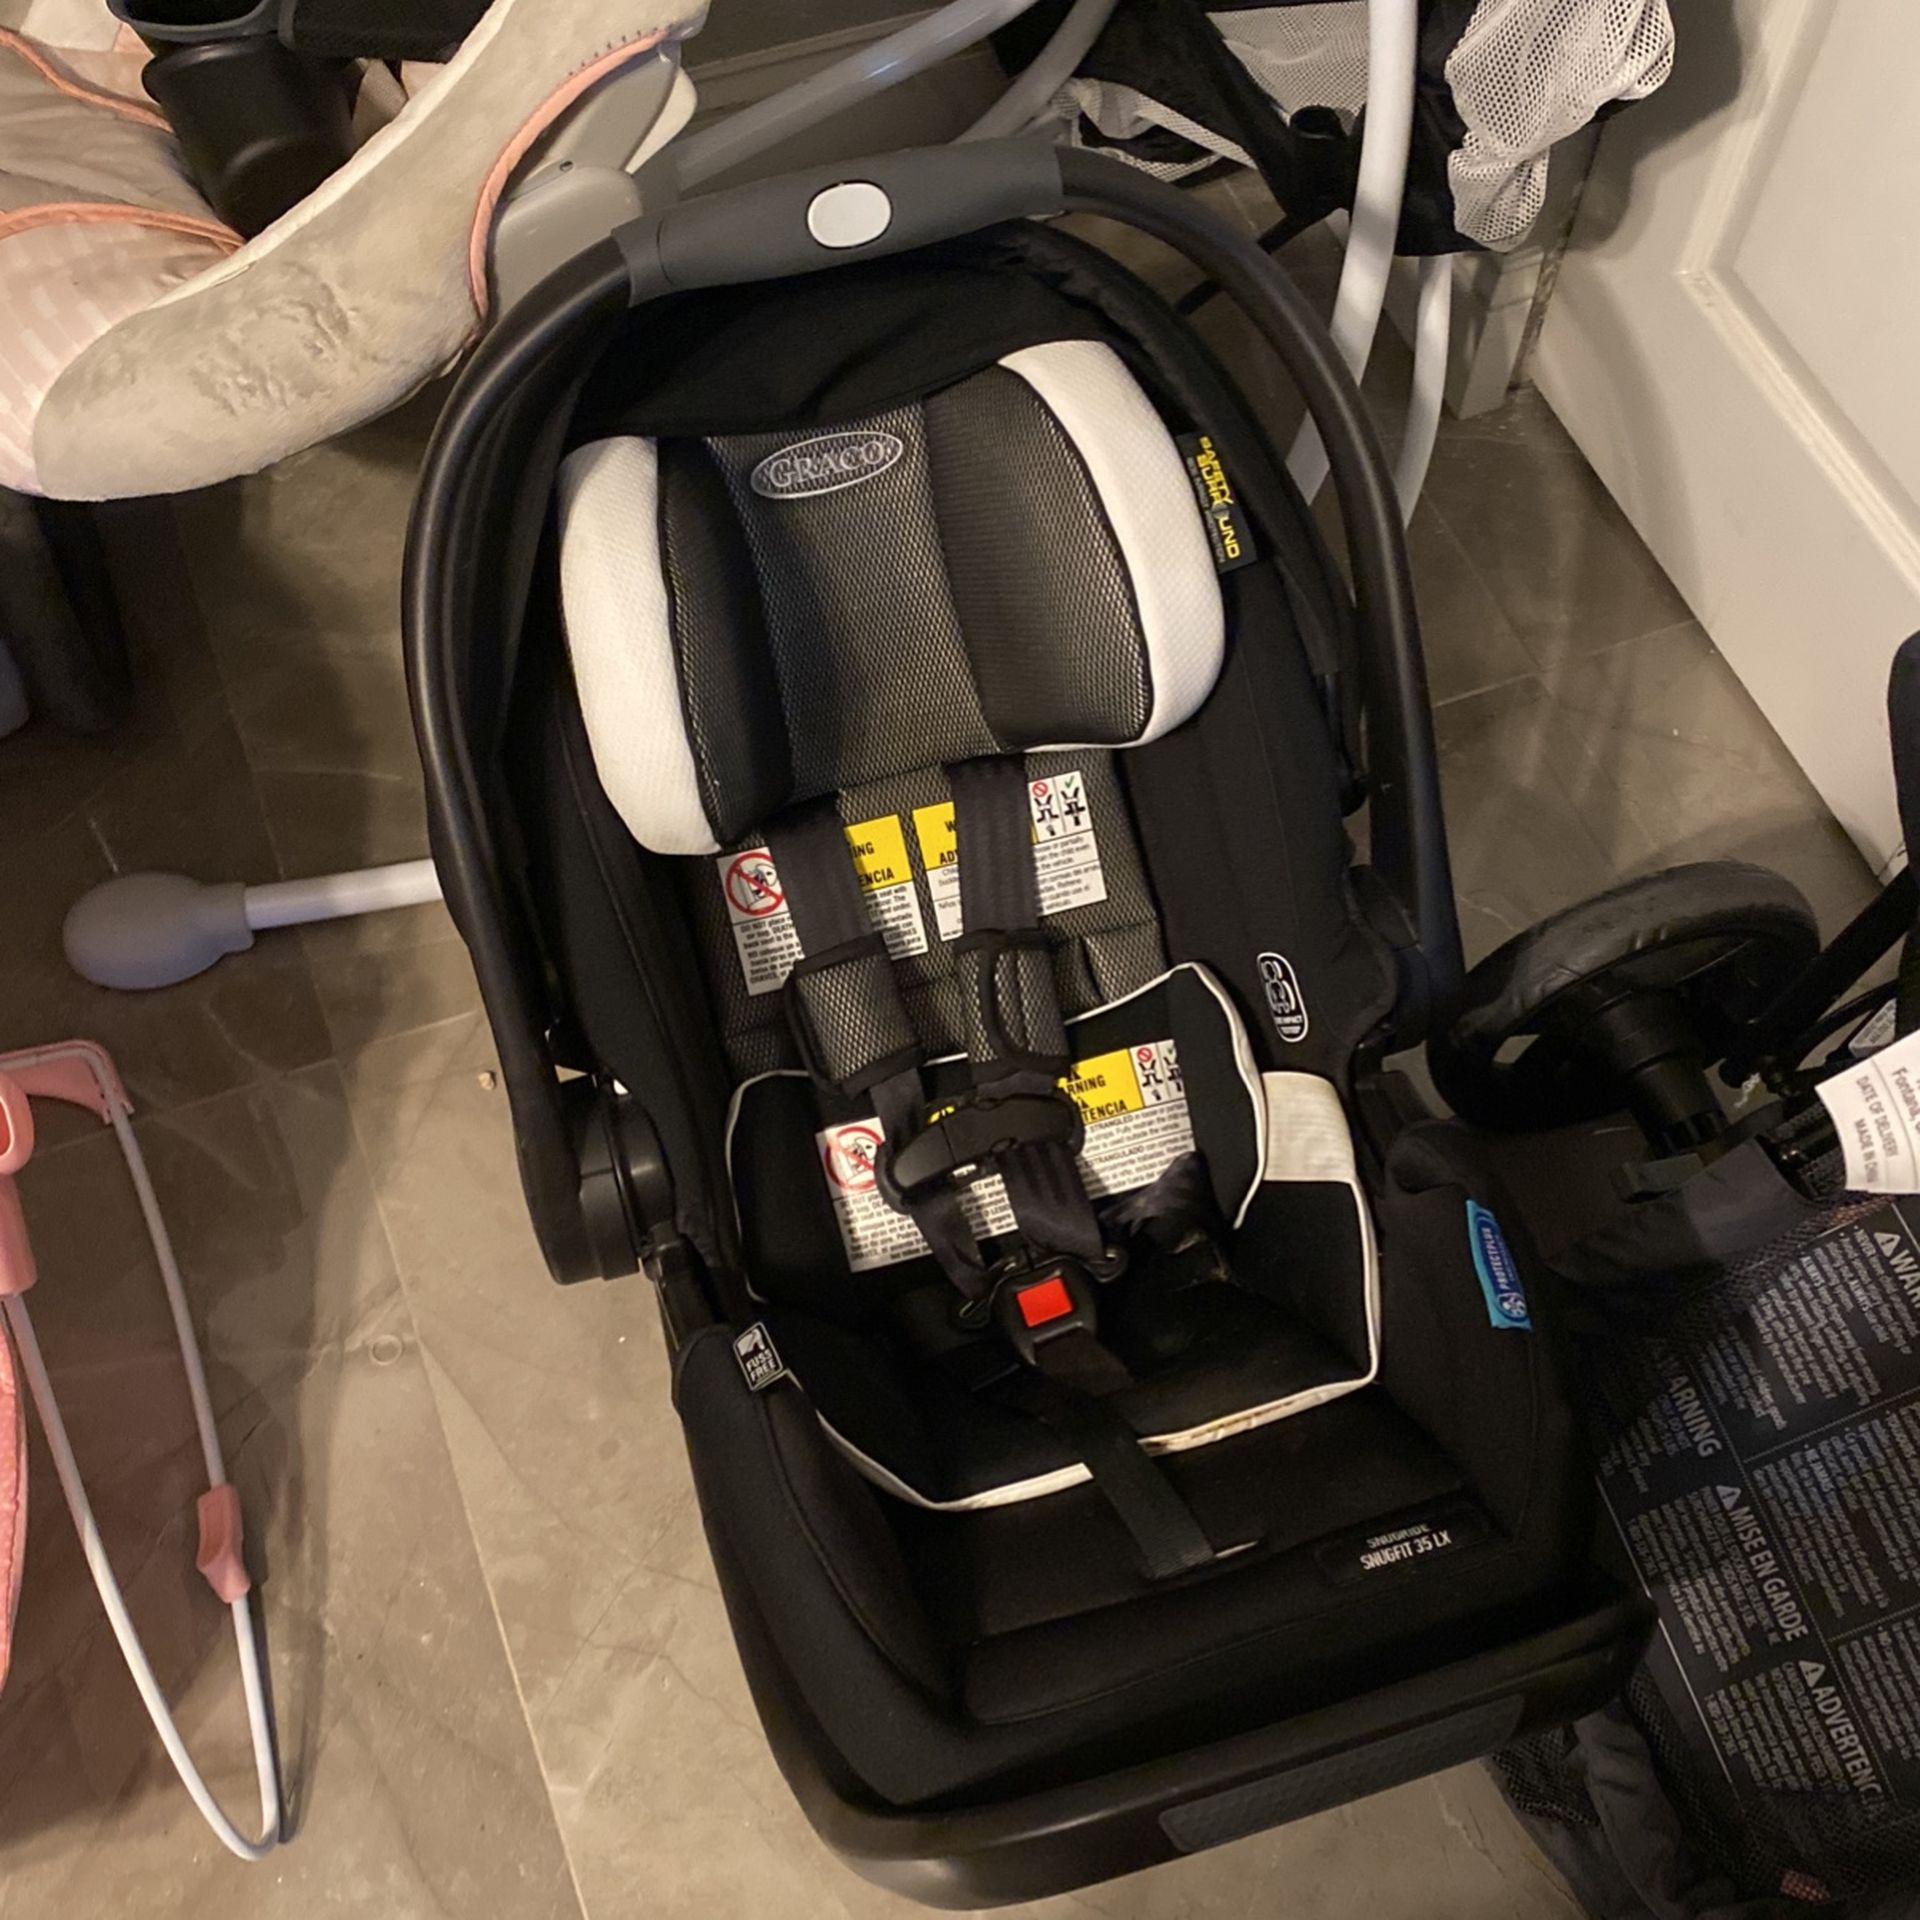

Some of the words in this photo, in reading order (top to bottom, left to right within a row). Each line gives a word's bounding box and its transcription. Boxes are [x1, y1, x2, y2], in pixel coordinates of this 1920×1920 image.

[769, 441, 884, 487] GRACO
[1200, 436, 1233, 504] SAFETY
[1066, 1075, 1106, 1097] RNING
[1856, 1075, 1877, 1102] DATE
[1890, 1066, 1920, 1121] Fontana,
[1081, 1100, 1128, 1122] TENCIA
[1867, 1100, 1884, 1116] OF
[1853, 1118, 1874, 1150] MADE
[1873, 1115, 1900, 1158] DELIVERY
[1863, 1149, 1876, 1162] IN
[746, 1349, 772, 1372] FUSS
[750, 1359, 776, 1381] FREE
[1366, 1524, 1430, 1549] SNUGRIDE
[1727, 1504, 1767, 1554] MISE
[1360, 1541, 1414, 1570] SNUGFIT
[1414, 1535, 1432, 1554] 35
[1433, 1530, 1452, 1547] LX
[1748, 1548, 1778, 1579] EN
[1760, 1574, 1809, 1643] GARDE
